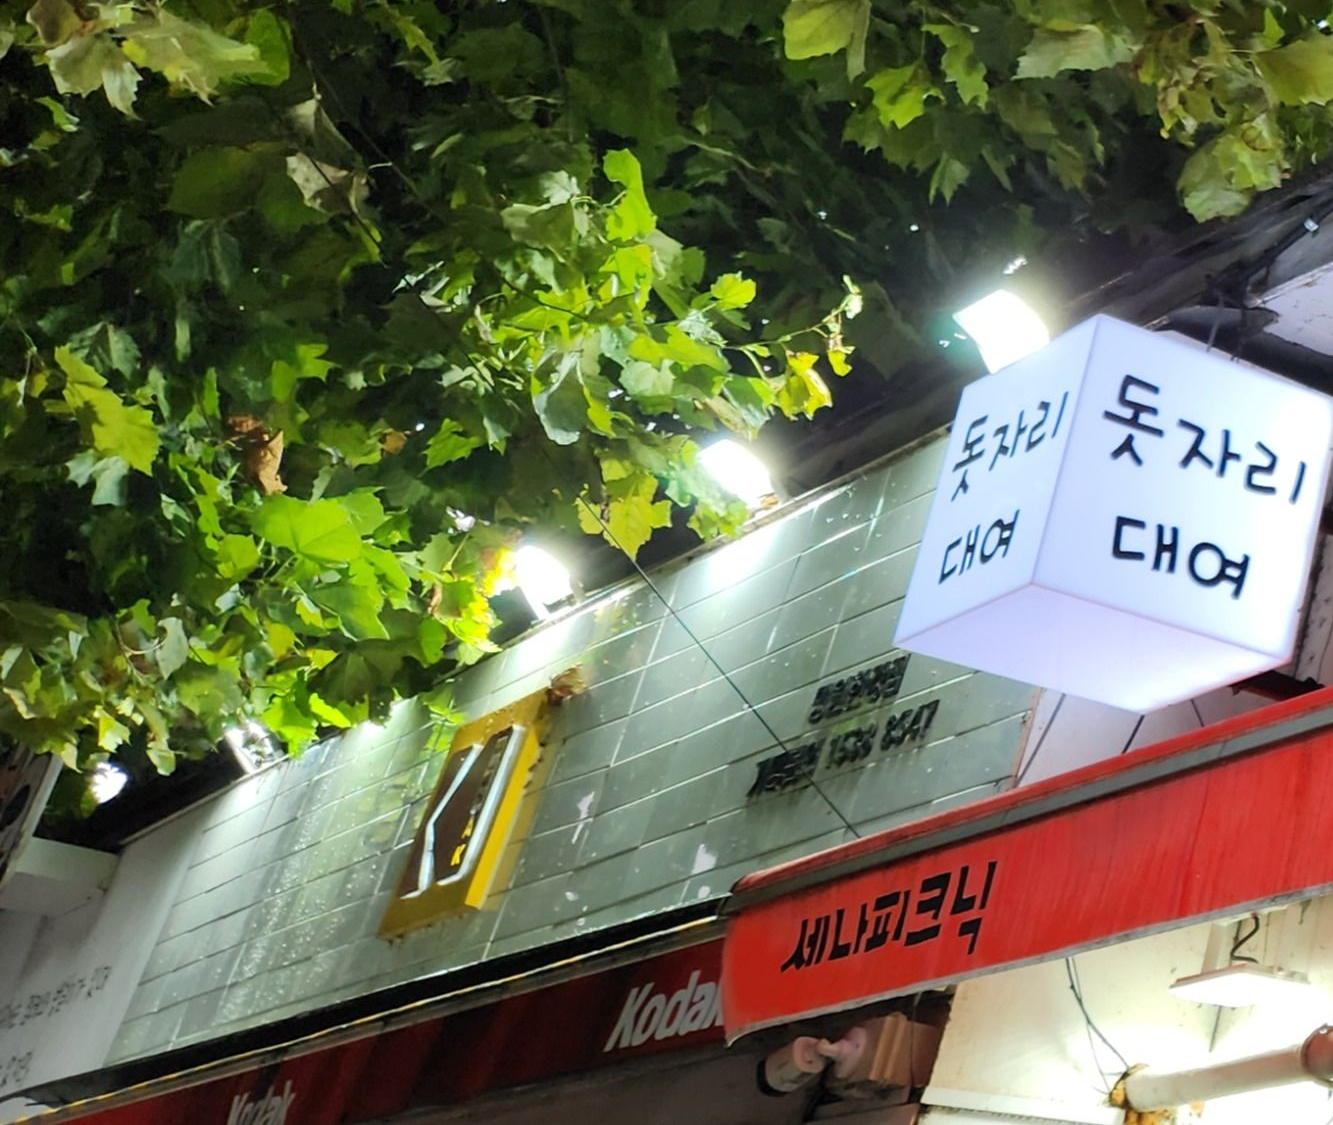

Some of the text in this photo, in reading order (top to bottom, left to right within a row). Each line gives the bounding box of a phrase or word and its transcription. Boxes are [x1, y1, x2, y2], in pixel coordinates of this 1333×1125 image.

[951, 390, 1069, 502] 돗자리
[1103, 374, 1306, 504] 돗자리
[939, 509, 1021, 585] 대여
[1112, 515, 1251, 599] 대여
[780, 861, 998, 973] 세나피크닉
